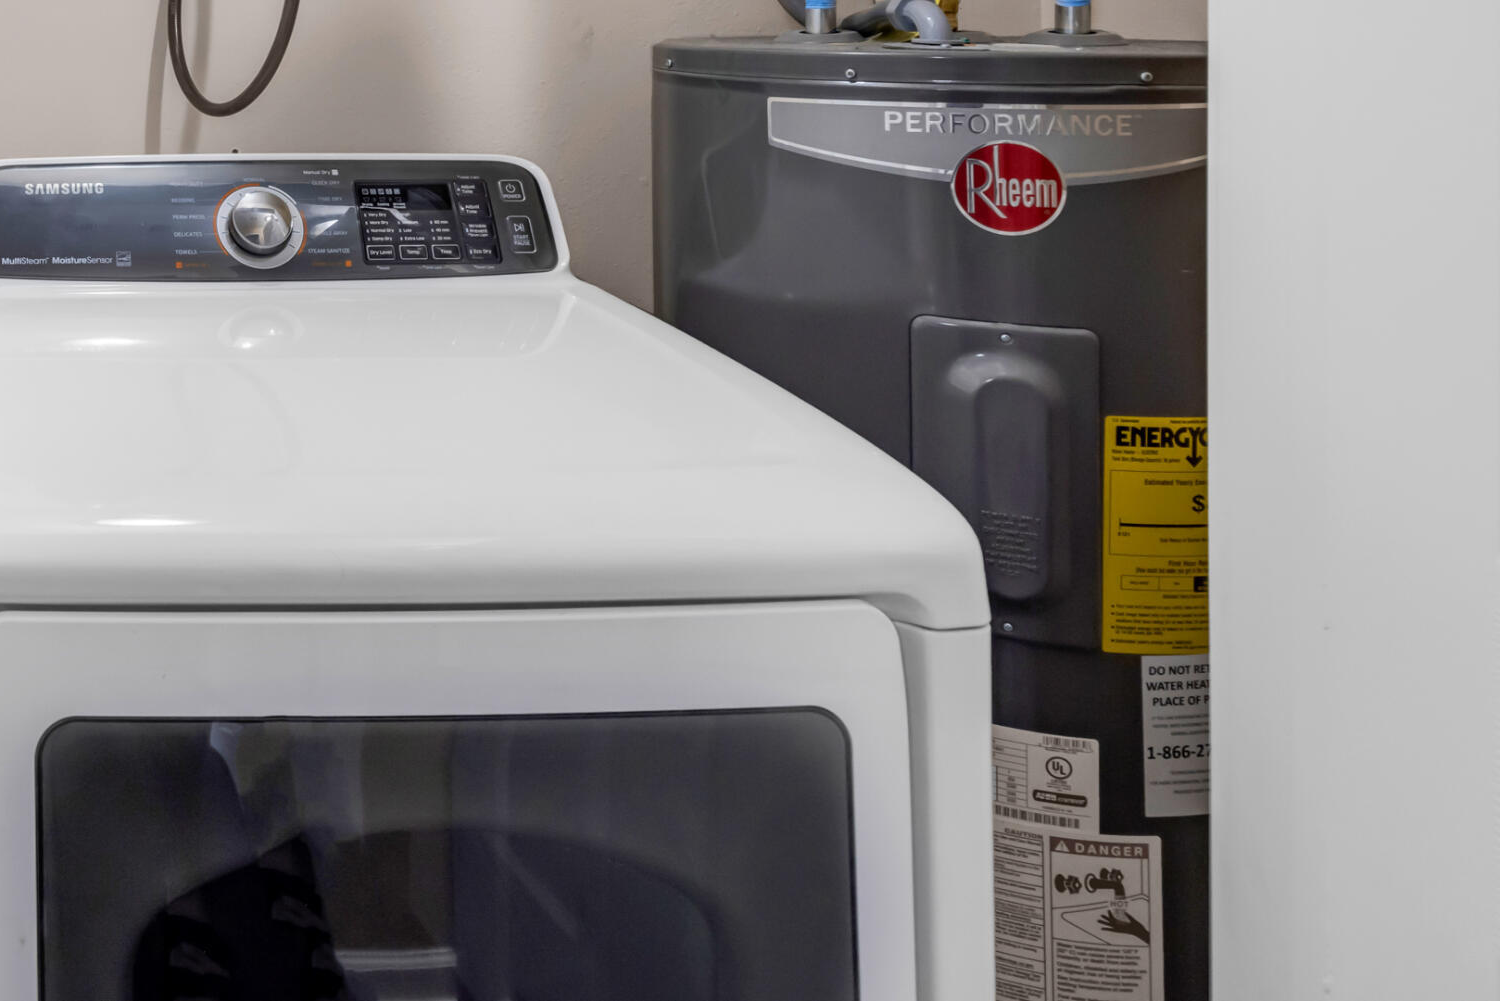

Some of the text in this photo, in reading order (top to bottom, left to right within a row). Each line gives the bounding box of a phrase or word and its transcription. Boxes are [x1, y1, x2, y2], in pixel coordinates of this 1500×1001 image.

[884, 110, 1133, 137] PERFORMANCE
[966, 145, 1058, 219] Rheem
[25, 182, 104, 195] SAMSUNG
[1, 257, 47, 265] MultiSteam
[1192, 494, 1205, 513] $
[1148, 666, 1165, 675] DO
[1168, 665, 1190, 675] NOT
[1146, 681, 1183, 691] WATER
[1152, 697, 1185, 707] PLACE
[1187, 695, 1201, 705] OF
[1075, 842, 1143, 857] DANGER
[1110, 900, 1129, 908] HOT
